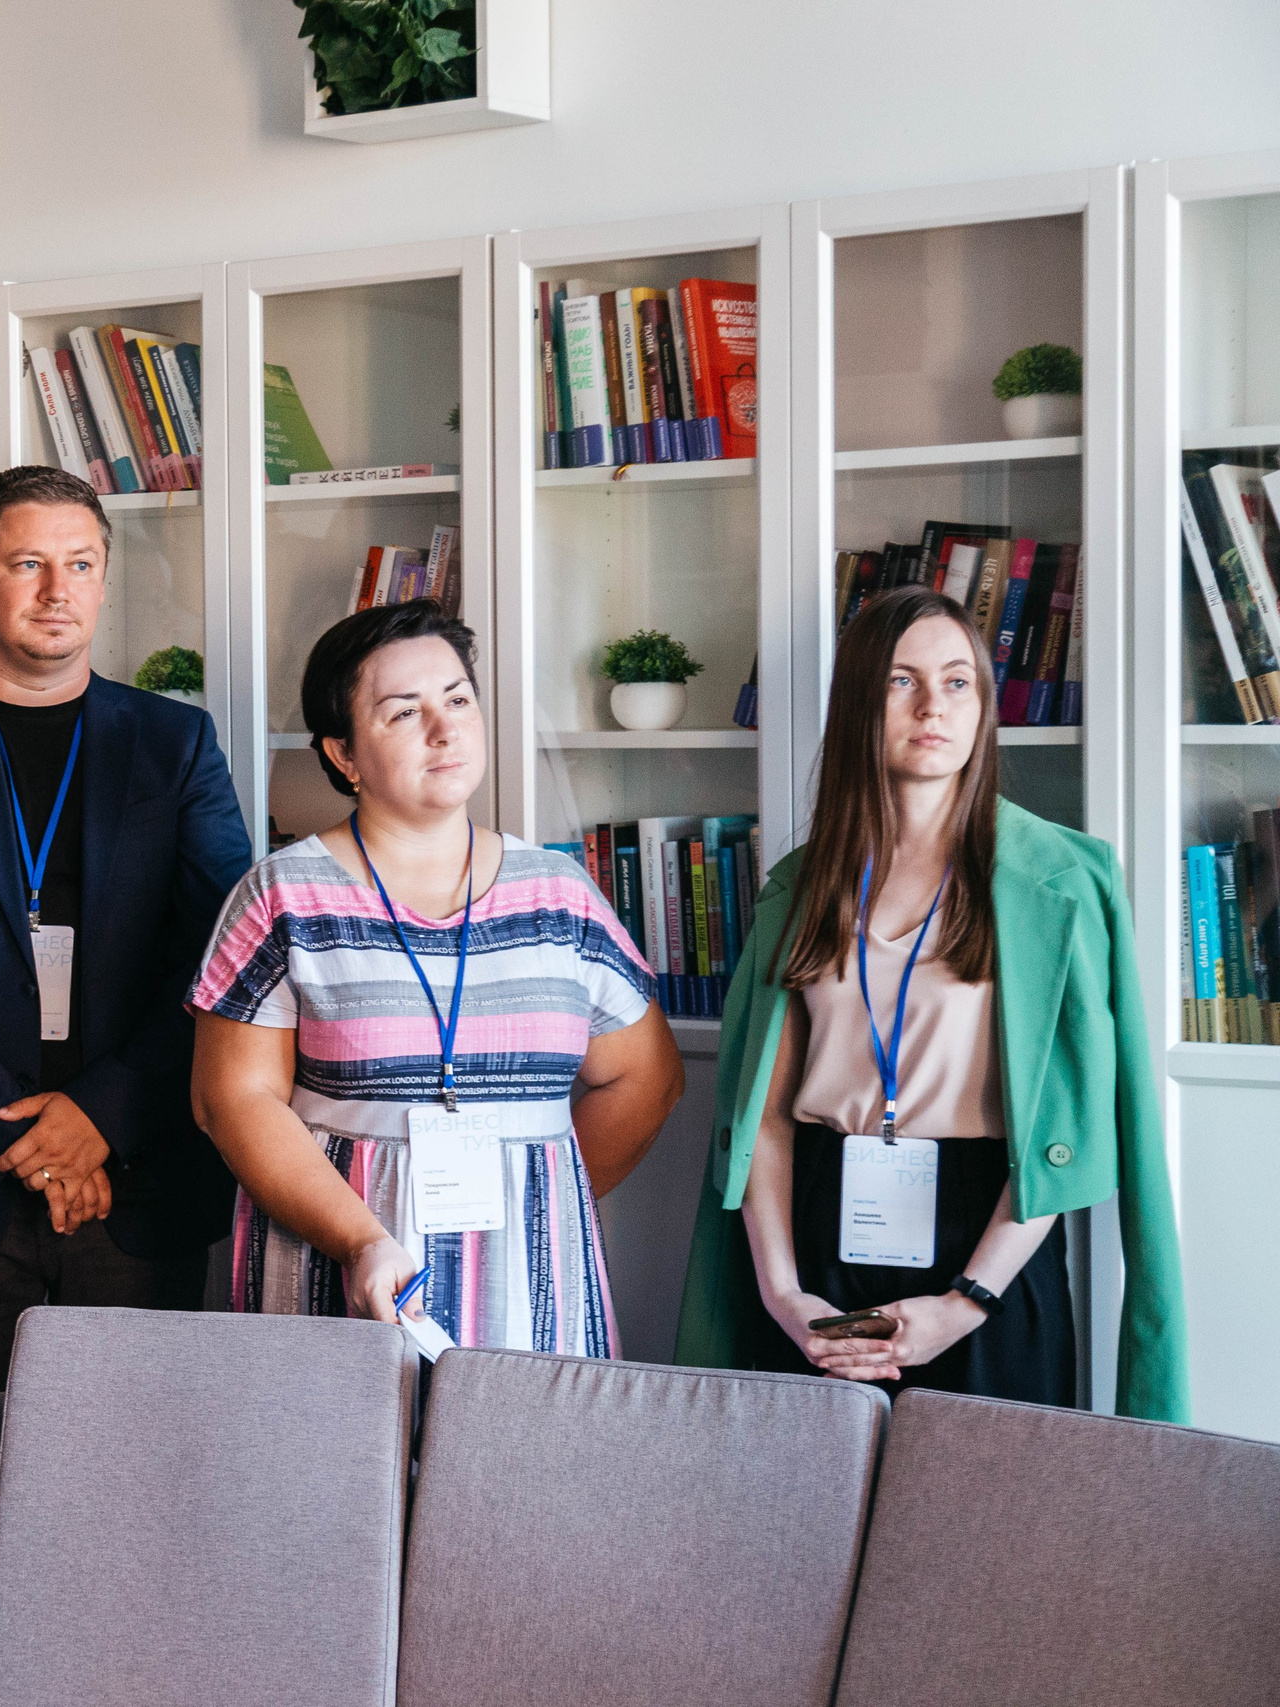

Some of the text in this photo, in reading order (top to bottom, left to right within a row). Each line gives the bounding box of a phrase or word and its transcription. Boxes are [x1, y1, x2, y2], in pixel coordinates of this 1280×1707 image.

[641, 322, 656, 355] ТАЙНА
[622, 322, 637, 390] ВАЖНЫЕ ГОДЫ
[40, 372, 57, 415] Сила воли
[75, 411, 91, 446] ОТ СРОЧНОГО
[973, 556, 1000, 618] ЦЕЛЬНАЯ
[597, 829, 611, 872] ПОЗДНИЙ
[621, 878, 631, 909] КАРНЕГИ
[1221, 883, 1237, 900] 101
[647, 897, 660, 945] ПСИХОЛОГИЯ
[666, 895, 681, 951] ПСИХОЛОГИЯ
[690, 872, 708, 952] ПРИНЯТИЕ РЕШЕНИЙ
[308, 940, 334, 949] LONDON
[1196, 917, 1211, 968] Сингапур
[313, 1002, 339, 1011] LONDON
[340, 1000, 359, 1009] HONG
[360, 999, 380, 1007] KONG
[481, 996, 522, 1007] AMSTERDAM
[392, 1076, 422, 1084] LONDON
[410, 1113, 500, 1135] БИЗНЕС
[460, 1134, 500, 1152] ТУР
[843, 1146, 938, 1167] БИЗНЕС
[895, 1170, 937, 1186] ТУР
